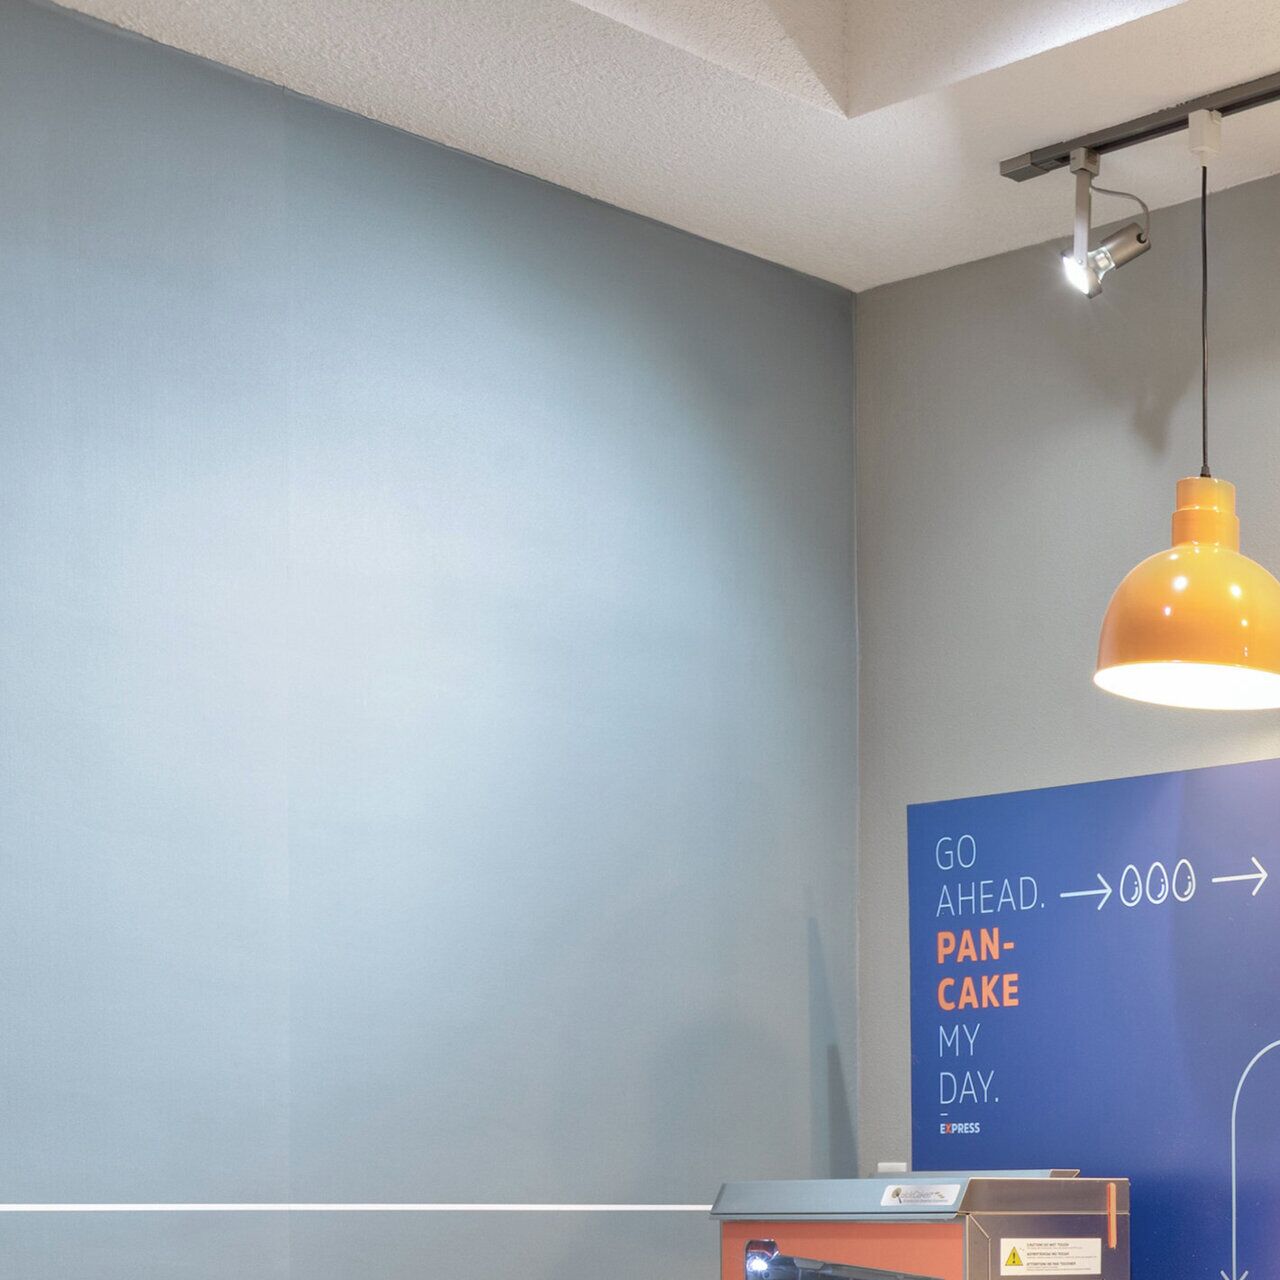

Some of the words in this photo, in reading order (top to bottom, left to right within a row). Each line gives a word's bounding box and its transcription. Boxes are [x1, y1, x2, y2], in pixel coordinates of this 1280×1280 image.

[936, 834, 977, 871] GO
[936, 876, 1046, 918] AHEAD.
[936, 927, 1016, 964] PAN-
[937, 973, 1020, 1011] CAKE
[938, 1022, 981, 1059] MY
[939, 1069, 1000, 1105] DAY.
[940, 1122, 981, 1135] EXPRESS
